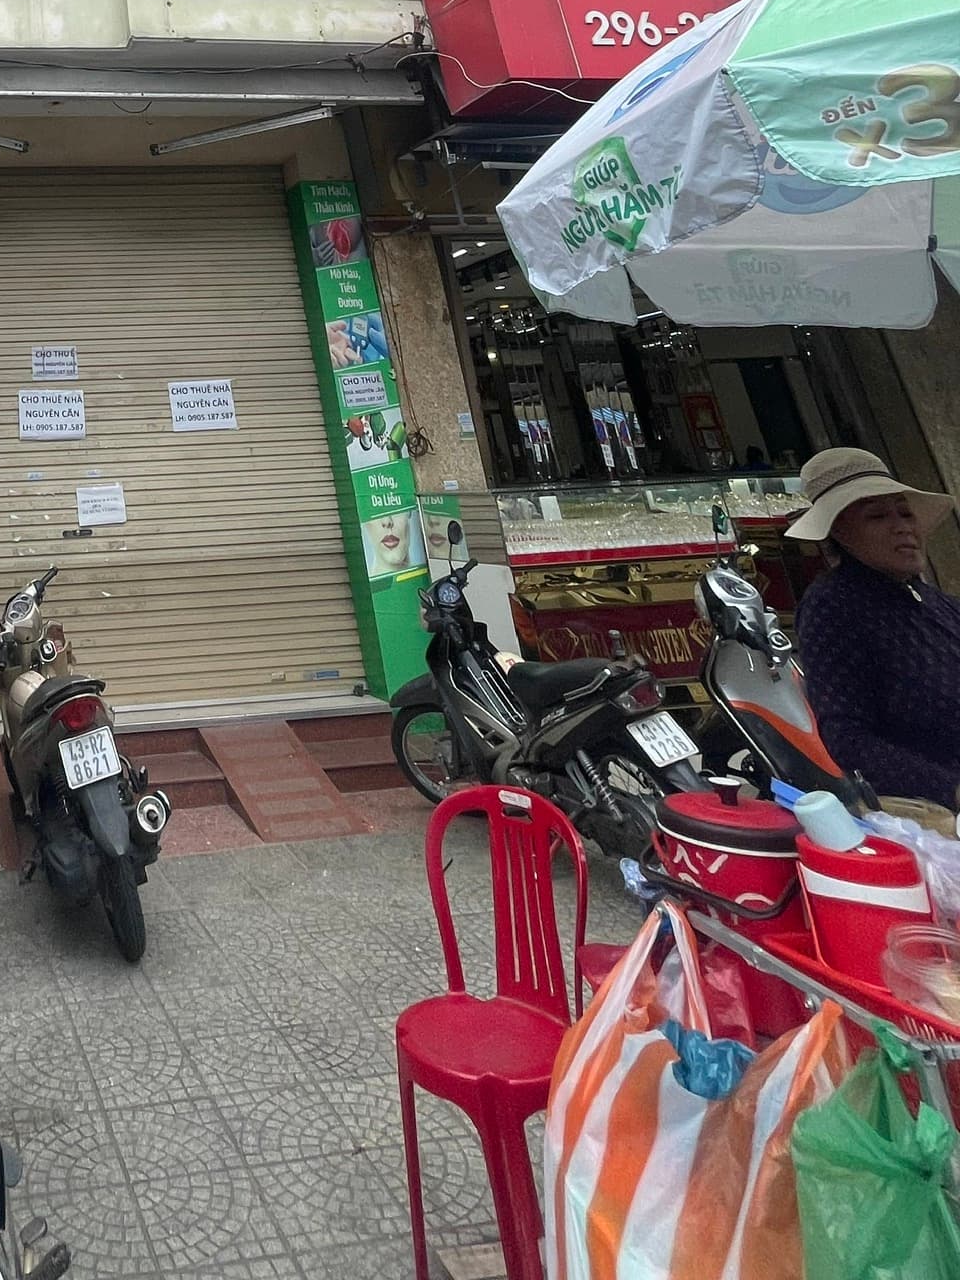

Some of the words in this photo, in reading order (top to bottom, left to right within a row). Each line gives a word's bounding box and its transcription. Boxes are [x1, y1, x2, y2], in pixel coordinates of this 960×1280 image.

[585, 10, 716, 46] 296-2
[822, 96, 877, 124] ĐẾN
[583, 157, 620, 190] GIÚP
[601, 183, 664, 222] HĂM
[171, 387, 188, 395] CHO
[190, 385, 212, 394] THUÊ
[213, 384, 231, 393] NHÀ
[343, 377, 360, 385] CHO
[41, 395, 62, 403] THUÊ
[66, 733, 107, 762] 43-R2
[650, 735, 689, 761] 1236
[73, 753, 111, 782] 8621
